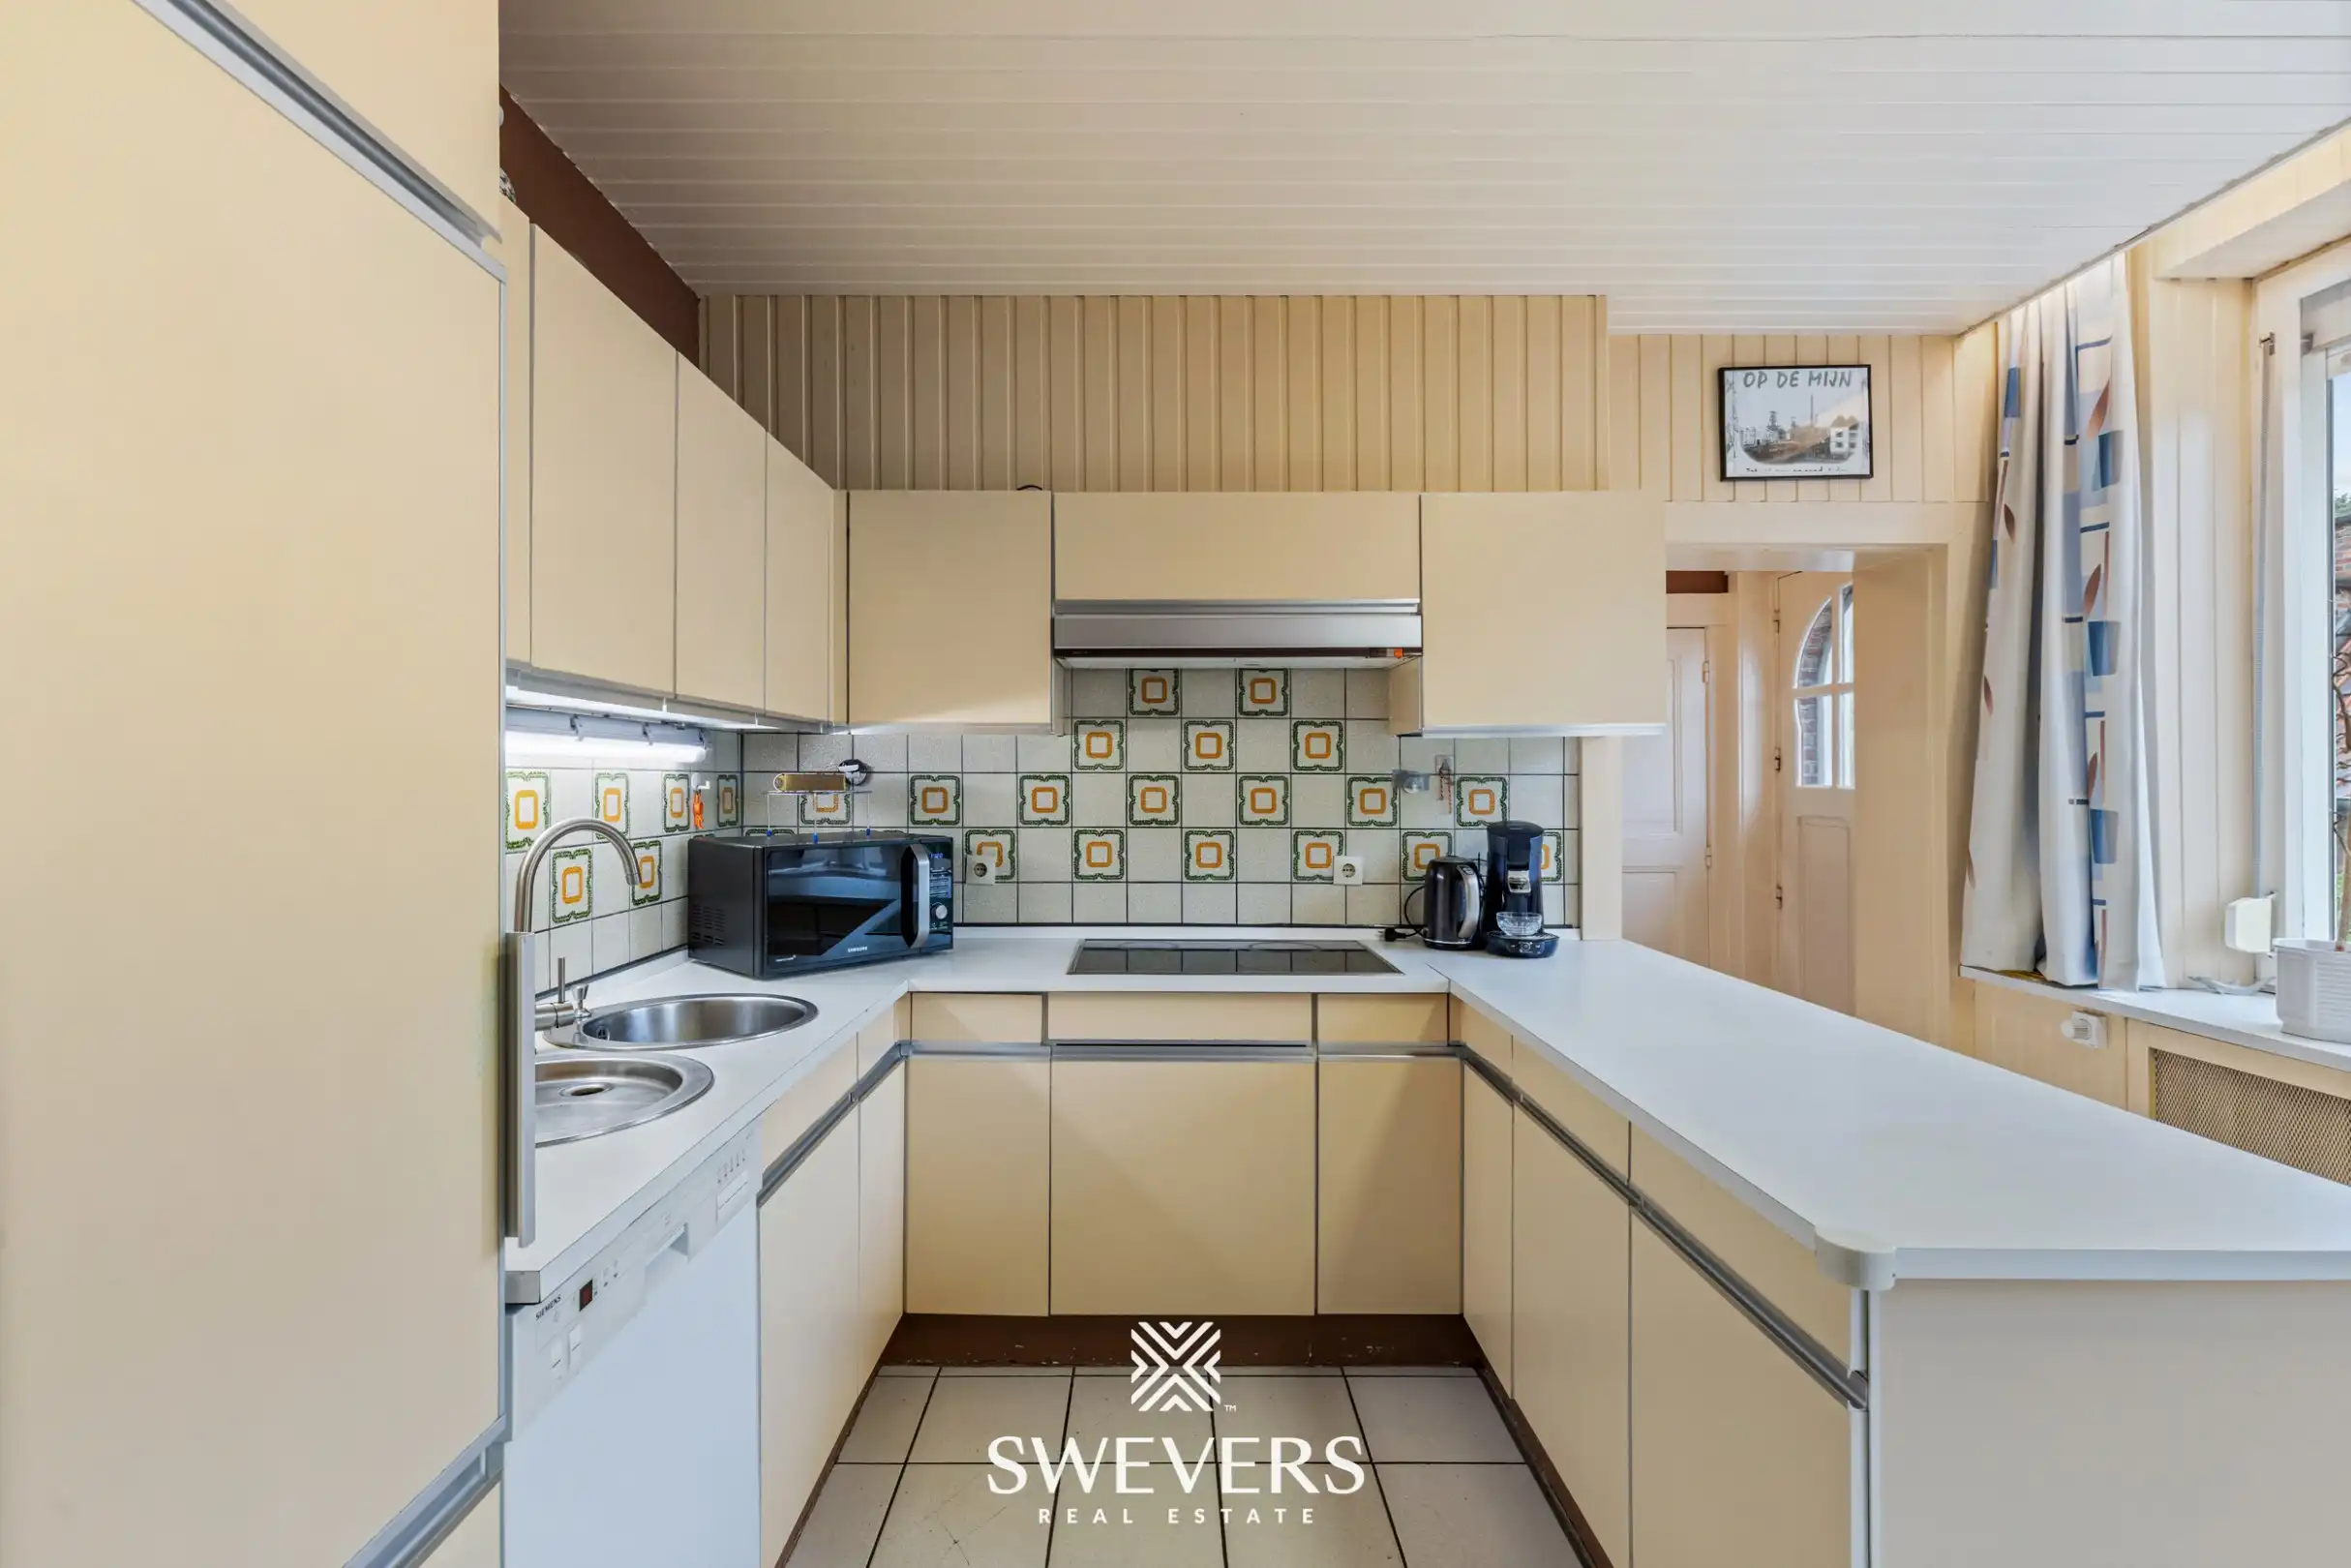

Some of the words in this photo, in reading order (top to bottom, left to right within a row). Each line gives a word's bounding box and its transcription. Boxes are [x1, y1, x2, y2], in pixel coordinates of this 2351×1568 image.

[1743, 370, 1767, 388] OP
[1776, 370, 1799, 388] DE
[1808, 370, 1852, 388] MIJN
[535, 1294, 561, 1321] SIEMENS
